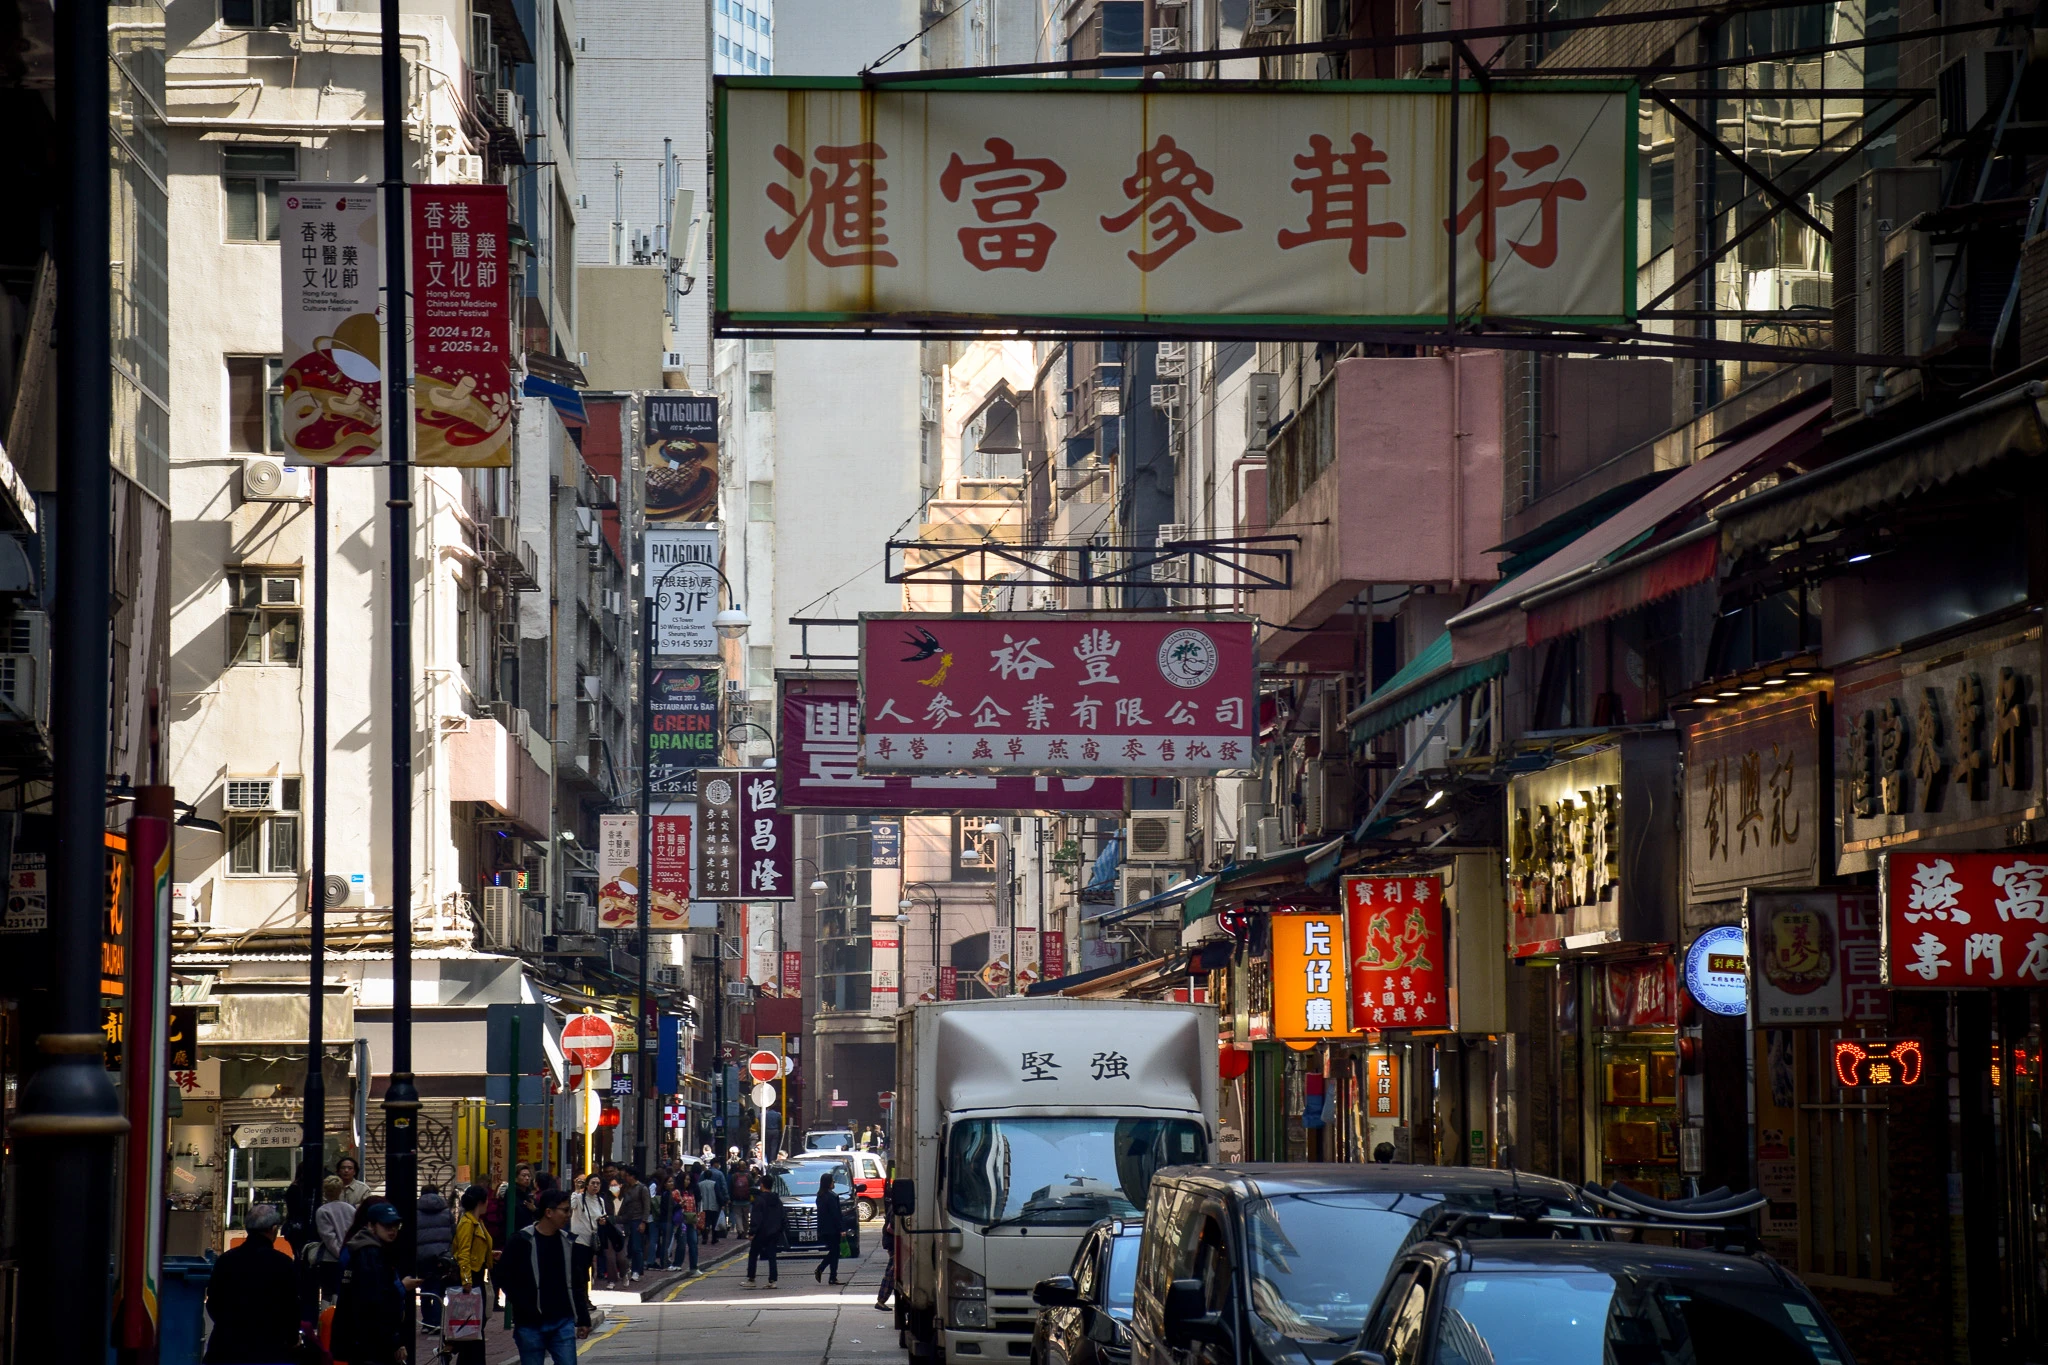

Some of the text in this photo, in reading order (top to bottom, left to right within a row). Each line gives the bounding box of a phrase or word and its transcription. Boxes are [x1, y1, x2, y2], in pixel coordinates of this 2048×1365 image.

[424, 202, 470, 228] 香港
[301, 222, 337, 242] 香港
[302, 245, 358, 265] 中醫藥
[426, 232, 496, 258] 中醫藥
[302, 268, 359, 288] 文化節
[426, 261, 497, 288] 文化節
[426, 290, 470, 299] Hong Kong
[426, 309, 457, 317] Culture
[652, 402, 712, 422] PATAGONIA
[652, 544, 712, 563] PATAGONIA
[675, 592, 708, 614] 3/F
[1167, 632, 1197, 645] GINSENG
[990, 628, 1121, 686] 裕豐
[650, 701, 692, 711] RESTAURANT
[701, 702, 715, 711] BAR
[874, 691, 1244, 730] 人參企業有限公司
[653, 714, 710, 731] GREEN
[650, 733, 713, 749] ORANGE
[1122, 739, 1244, 761] 零售批發
[657, 822, 675, 833] 香港
[748, 778, 784, 891] 恒昌隆
[1355, 880, 1432, 905] 寶利華
[1904, 859, 2048, 925] 燕窩
[1905, 932, 2048, 981] 專門店
[1304, 921, 1332, 1032] 片仔癀
[1361, 991, 1437, 1008] 美國野山
[1372, 1006, 1428, 1023] 花旗參
[1021, 1051, 1131, 1082] 堅強
[1869, 1043, 1892, 1084] 二樓
[243, 1126, 297, 1135] Cleverly Street
[250, 1136, 291, 1146] 急庇利街
